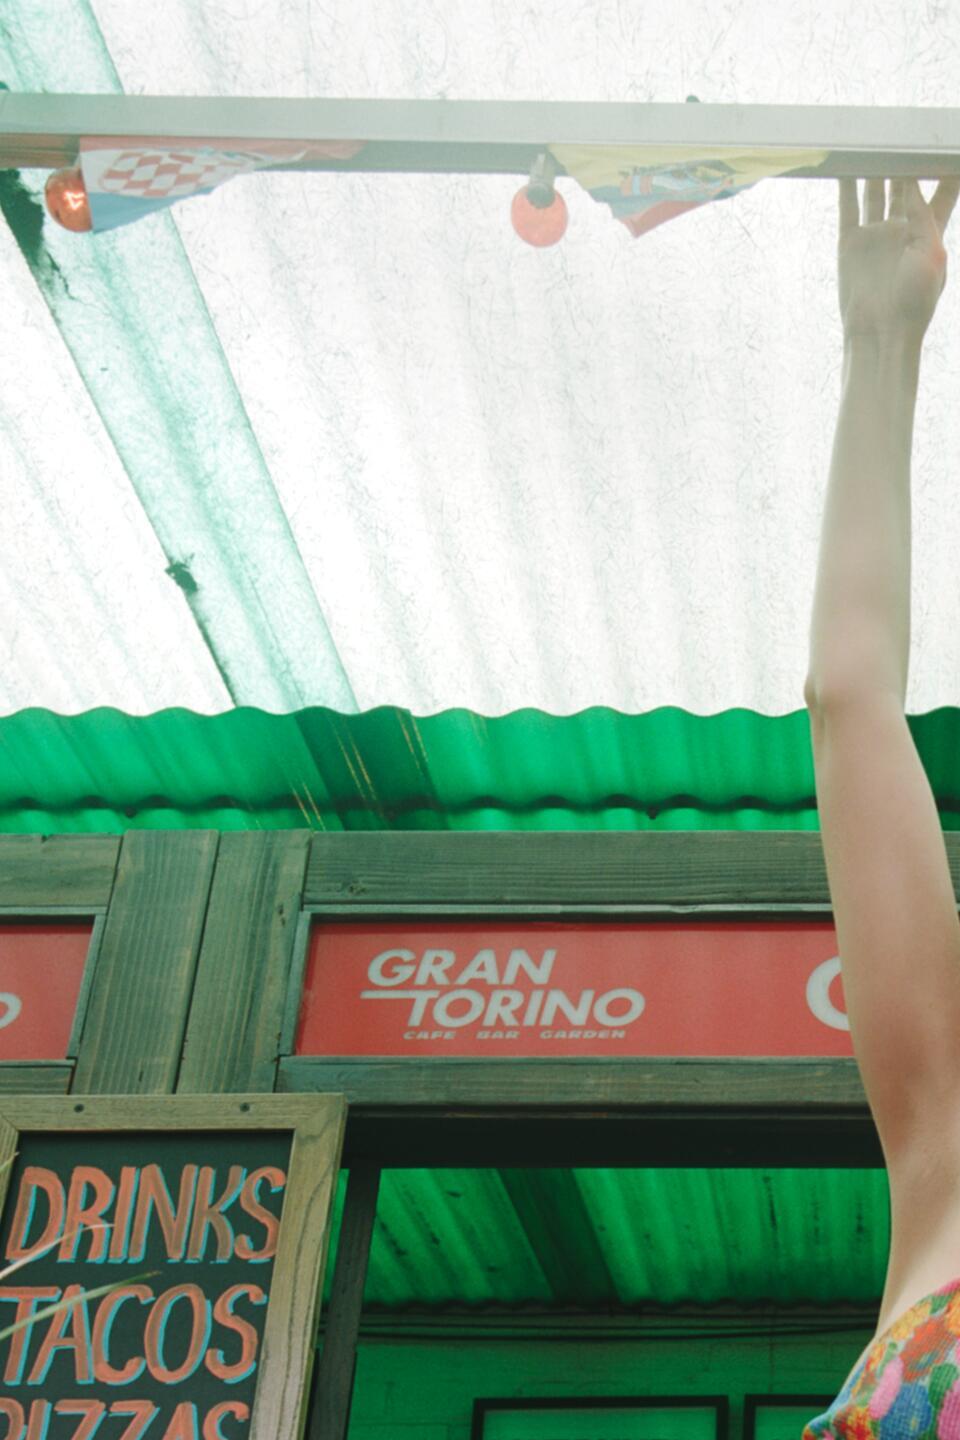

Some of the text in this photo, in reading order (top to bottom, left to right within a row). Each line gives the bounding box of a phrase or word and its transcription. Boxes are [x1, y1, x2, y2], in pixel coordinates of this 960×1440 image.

[367, 948, 557, 987] GRAN
[360, 988, 646, 1028] TORINO
[475, 1029, 520, 1040] BAR
[540, 1029, 626, 1040] GARDEN
[5, 1163, 287, 1264] DRINKS
[0, 1283, 268, 1386] TACOS
